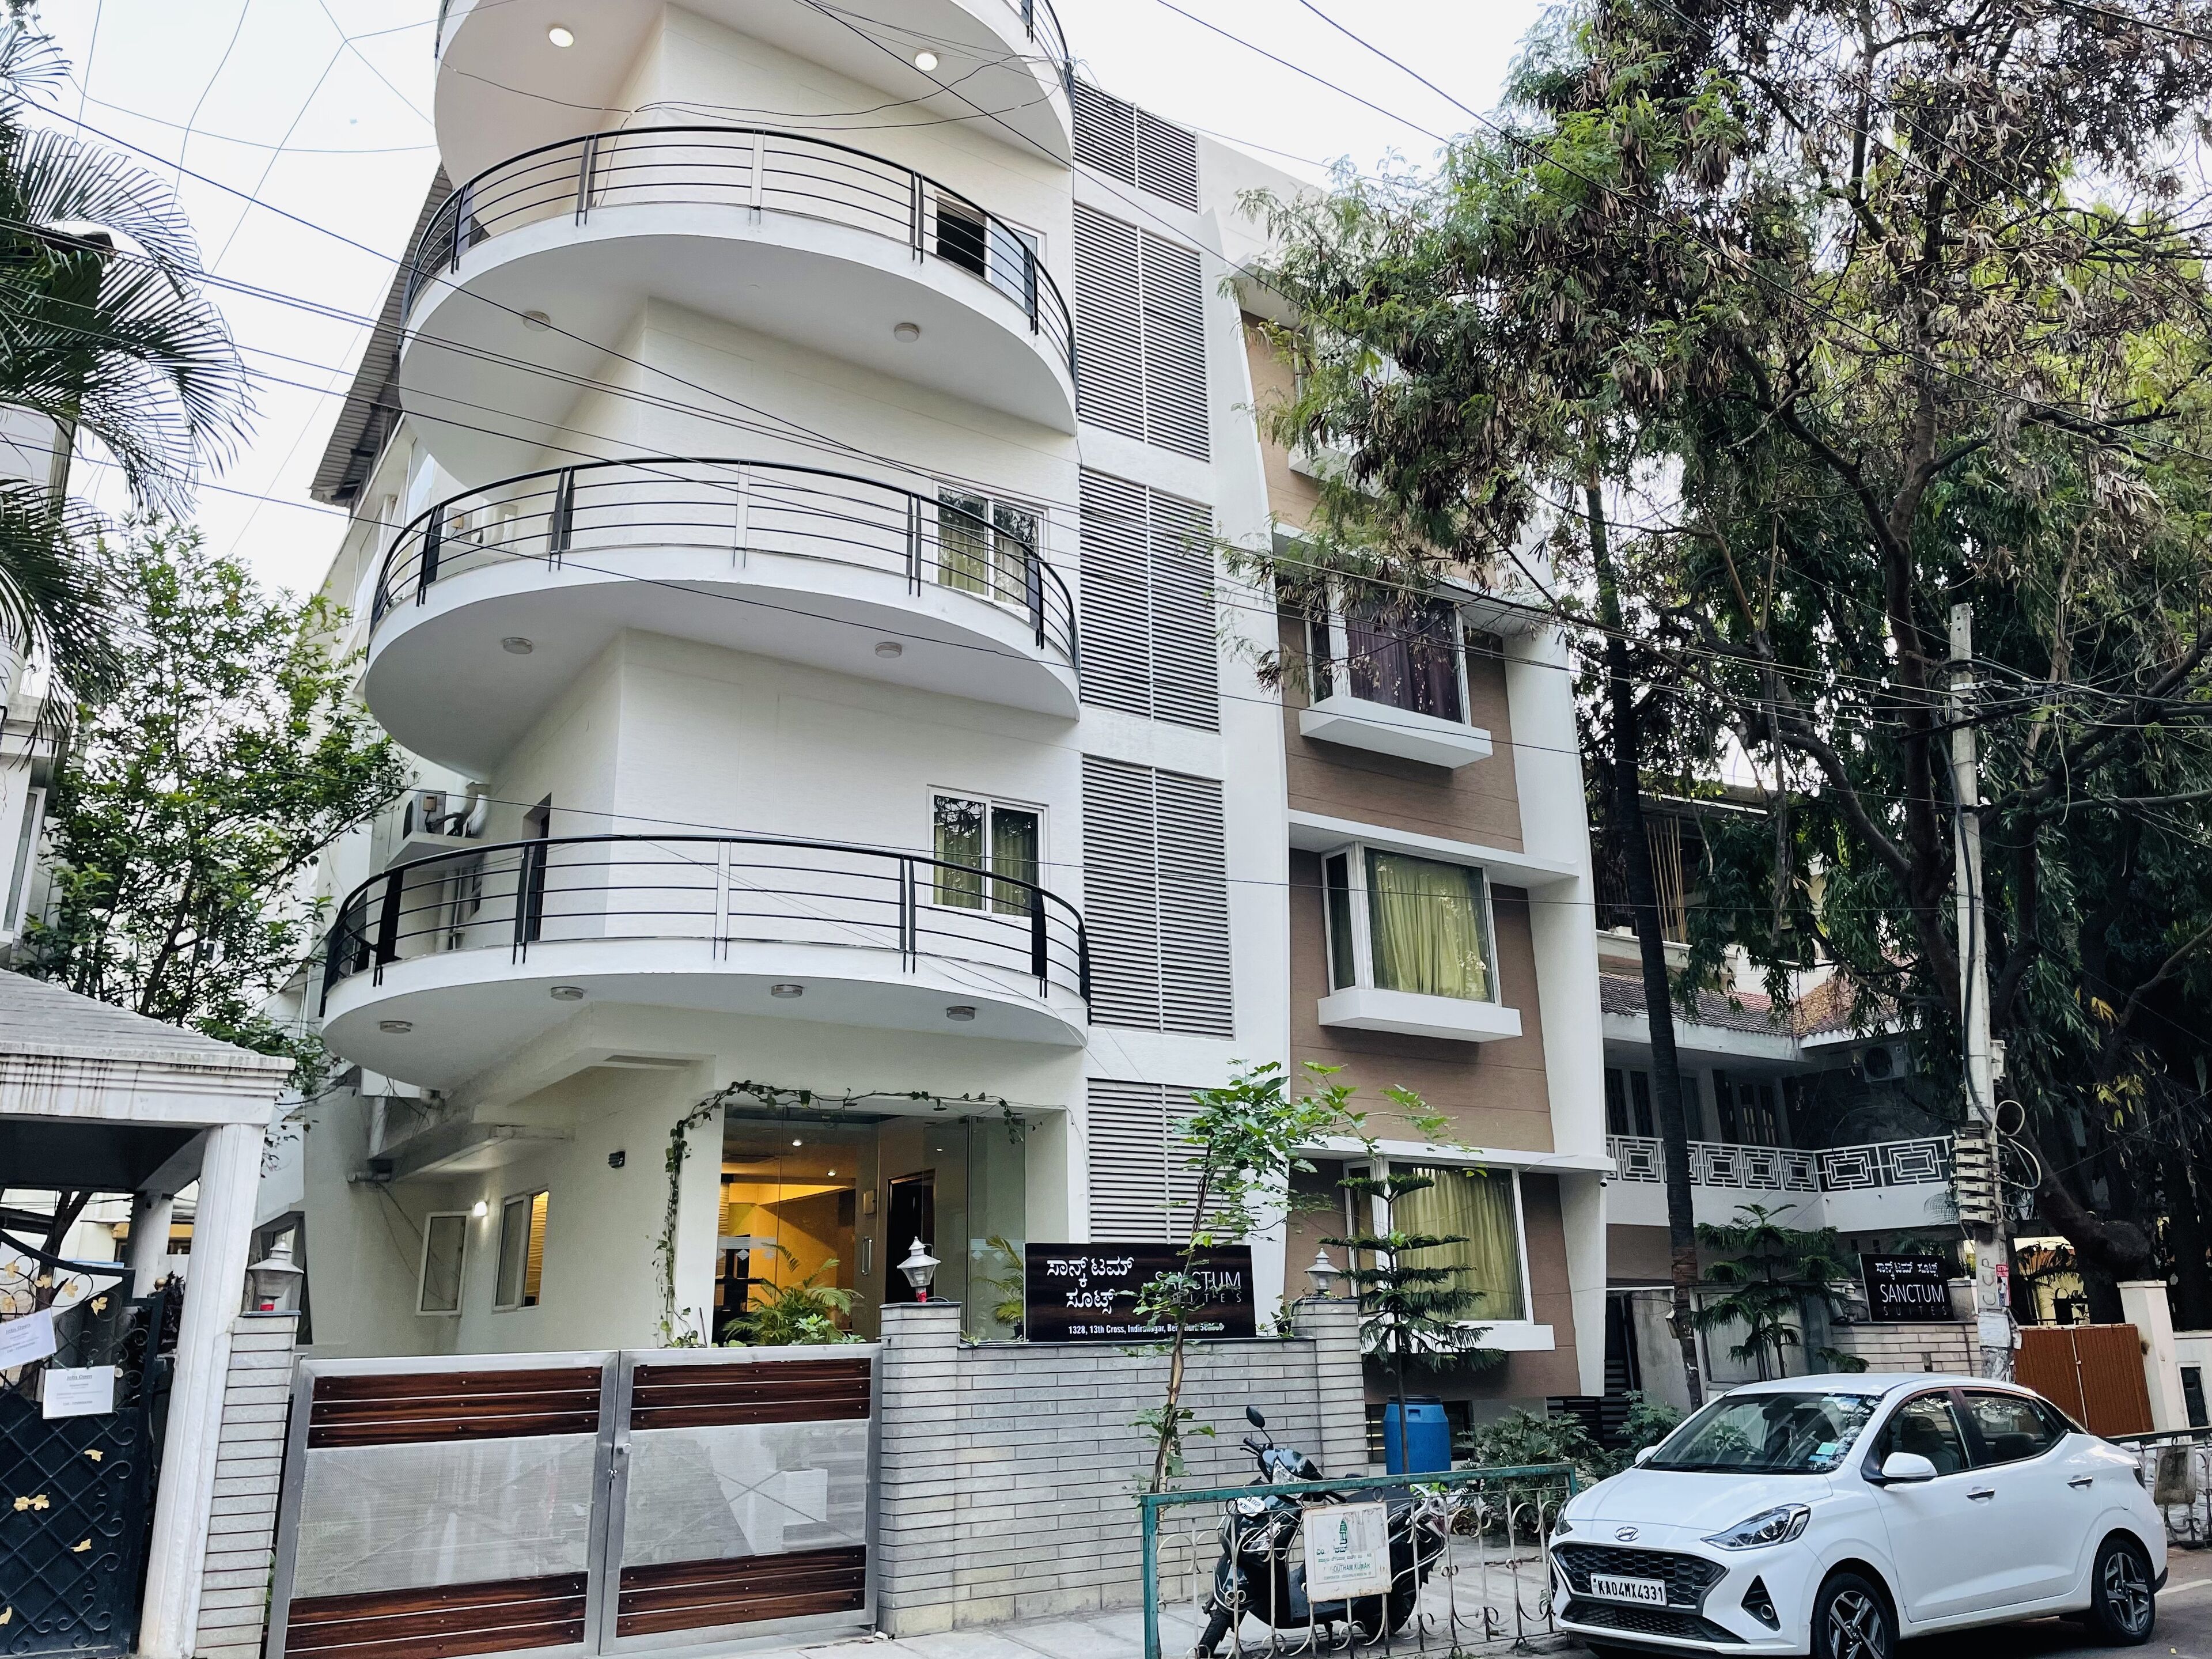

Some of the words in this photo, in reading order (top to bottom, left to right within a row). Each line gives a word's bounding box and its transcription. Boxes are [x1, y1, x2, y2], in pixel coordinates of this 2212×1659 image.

[1880, 1283, 1945, 1303] SANCTUM
[1883, 1305, 1947, 1316] SUITES
[1069, 1325, 1088, 1335] 1328,
[1090, 1325, 1105, 1334] 13th
[1106, 1324, 1126, 1334] Cross,
[1598, 1580, 1663, 1601] KA04MX4331
